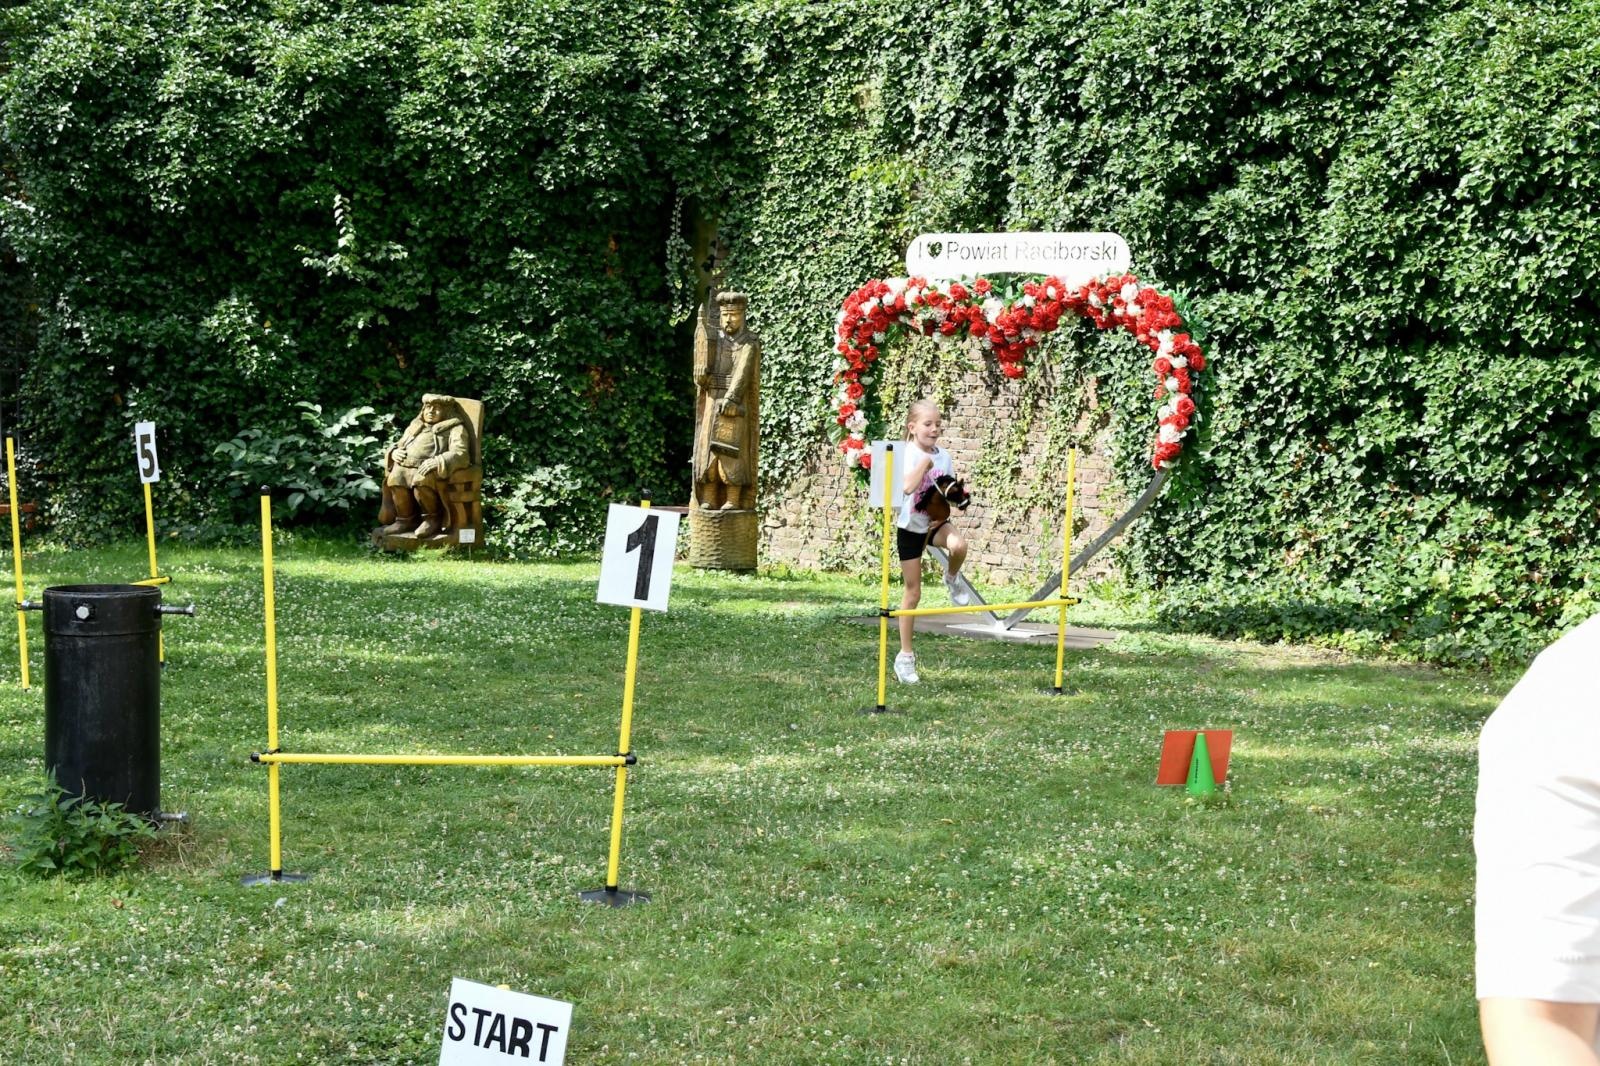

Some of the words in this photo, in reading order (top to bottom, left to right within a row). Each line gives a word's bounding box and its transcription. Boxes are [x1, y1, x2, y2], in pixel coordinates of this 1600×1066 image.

[946, 241, 1008, 260] Powiat
[1015, 240, 1117, 260] Raciborski
[140, 433, 155, 478] 5
[625, 514, 660, 601] 1
[447, 1002, 559, 1062] START
